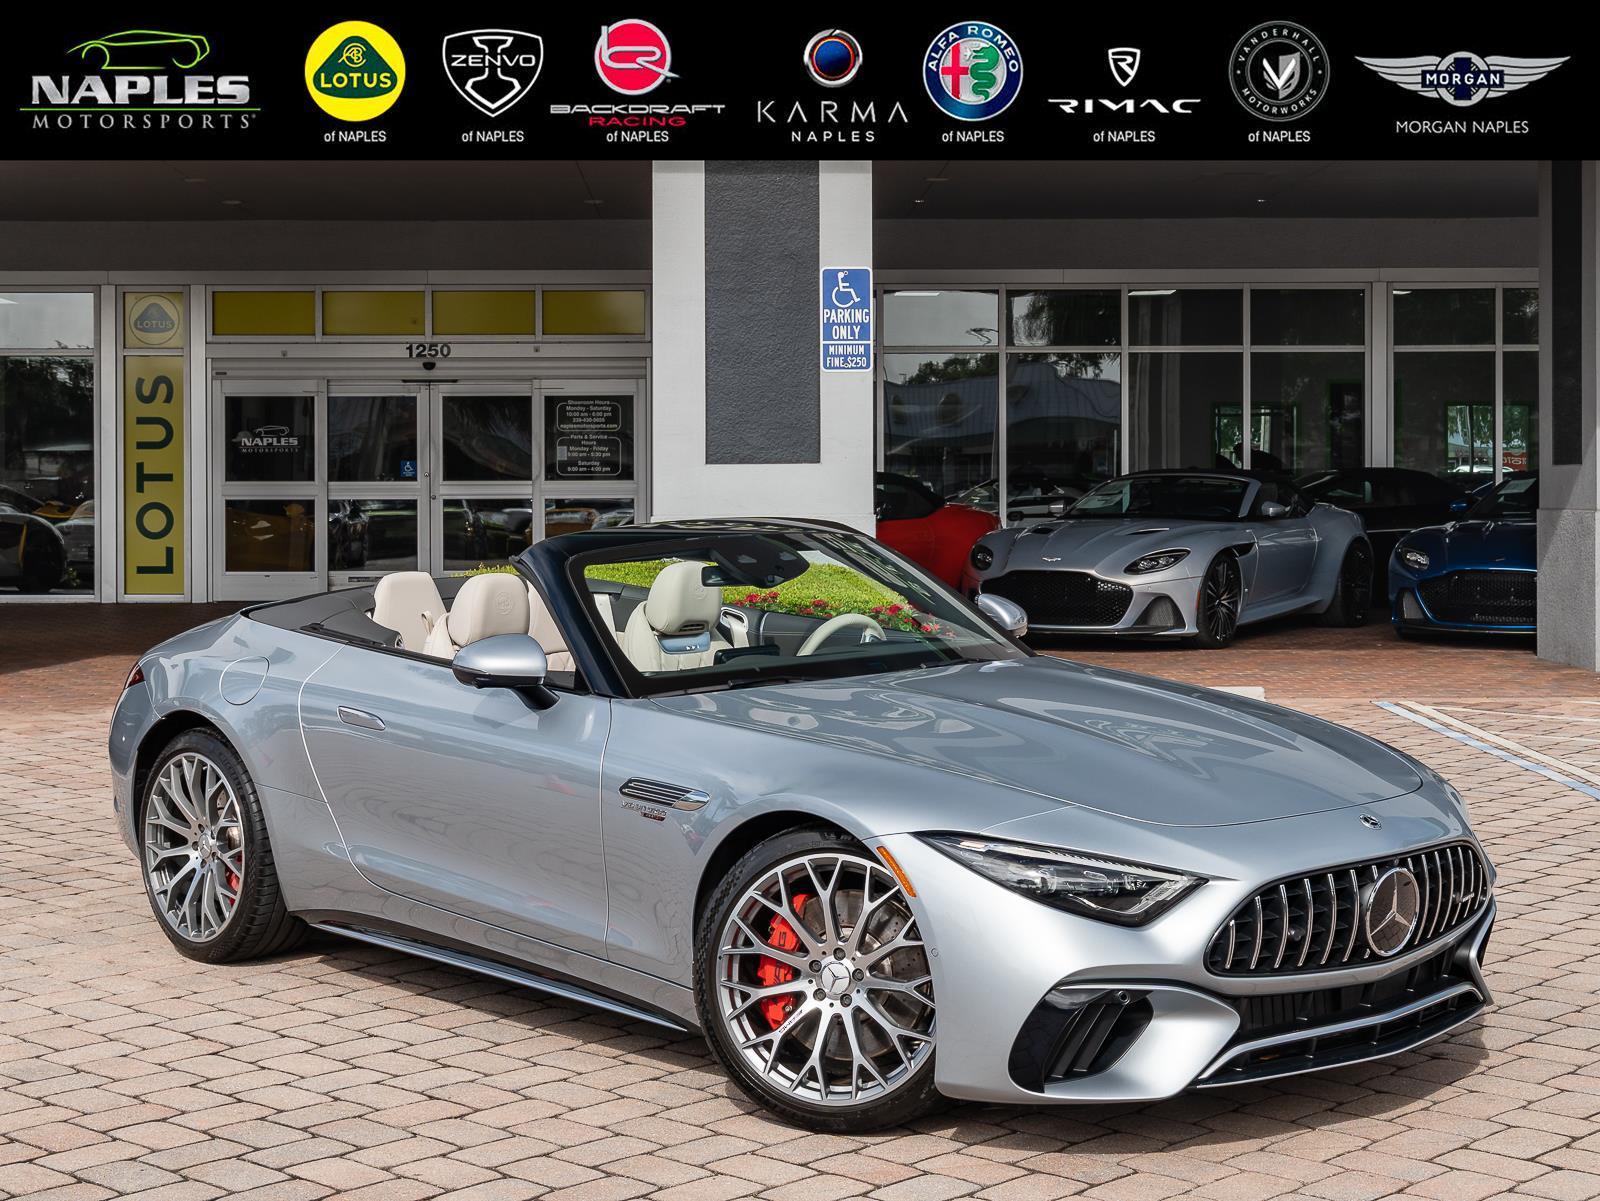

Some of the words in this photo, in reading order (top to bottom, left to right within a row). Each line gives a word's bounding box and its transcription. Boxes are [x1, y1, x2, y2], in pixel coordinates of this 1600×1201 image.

[823, 308, 870, 323] PARKING
[137, 320, 174, 329] LOTUS
[832, 325, 861, 340] ONLY
[405, 343, 451, 358] 1250
[828, 344, 865, 355] MINIMUM
[826, 357, 845, 367] FINE
[847, 356, 867, 368] $250
[241, 437, 298, 446] NAPLES
[136, 375, 174, 575] LOTUS
